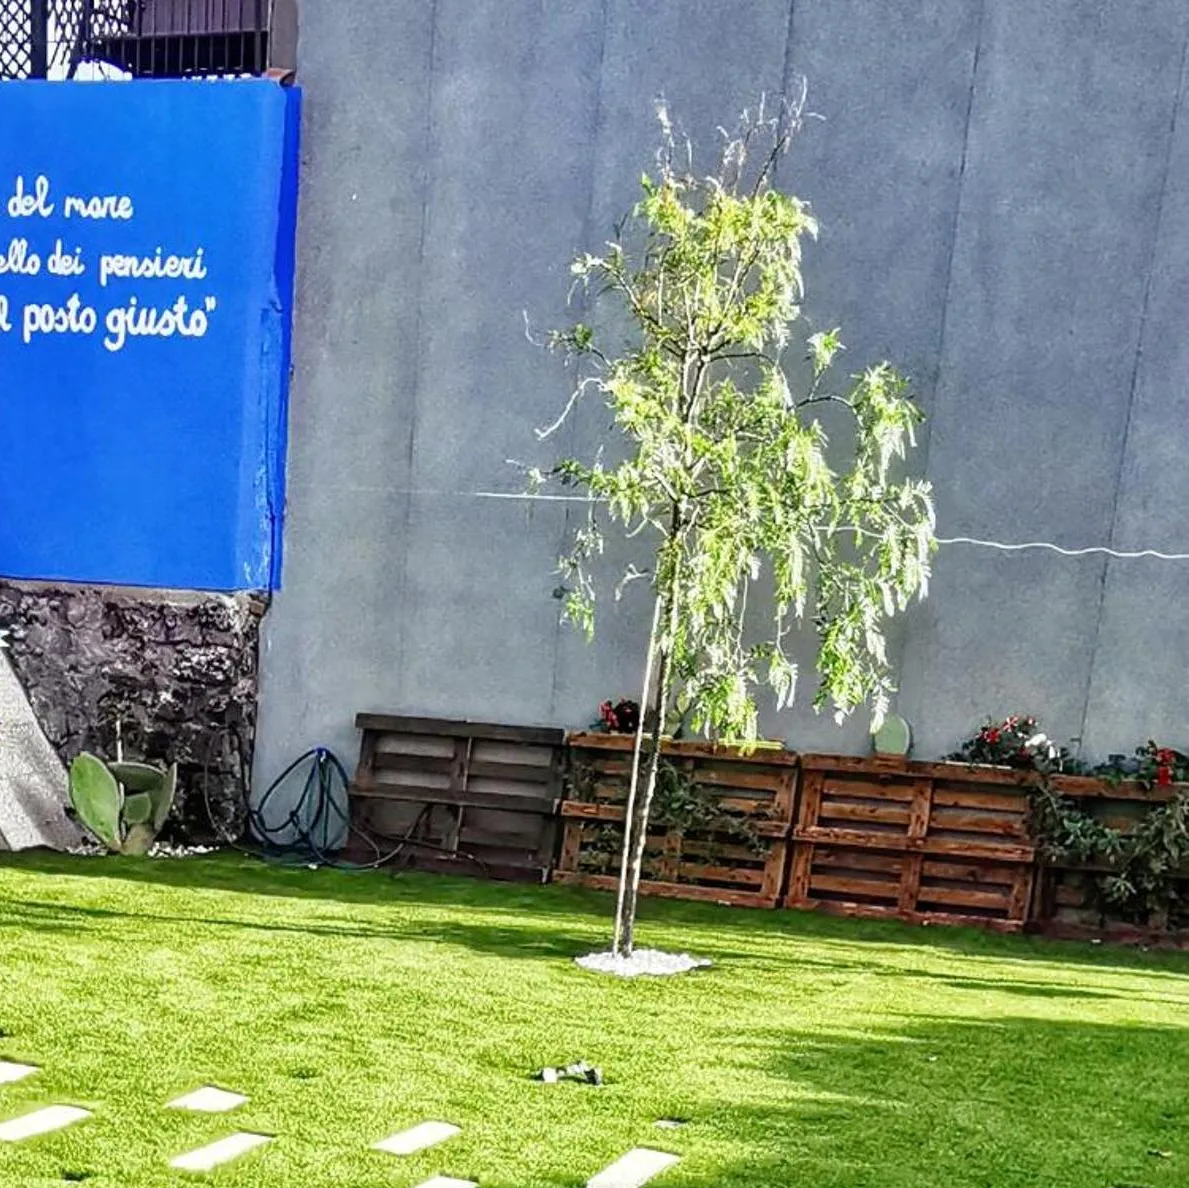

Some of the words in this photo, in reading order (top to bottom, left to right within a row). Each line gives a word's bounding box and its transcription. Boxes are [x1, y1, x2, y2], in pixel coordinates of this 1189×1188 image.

[7, 175, 54, 218] del
[64, 194, 133, 219] mare
[47, 239, 85, 276] dei
[100, 247, 207, 286] pensieri
[23, 293, 97, 343] posto
